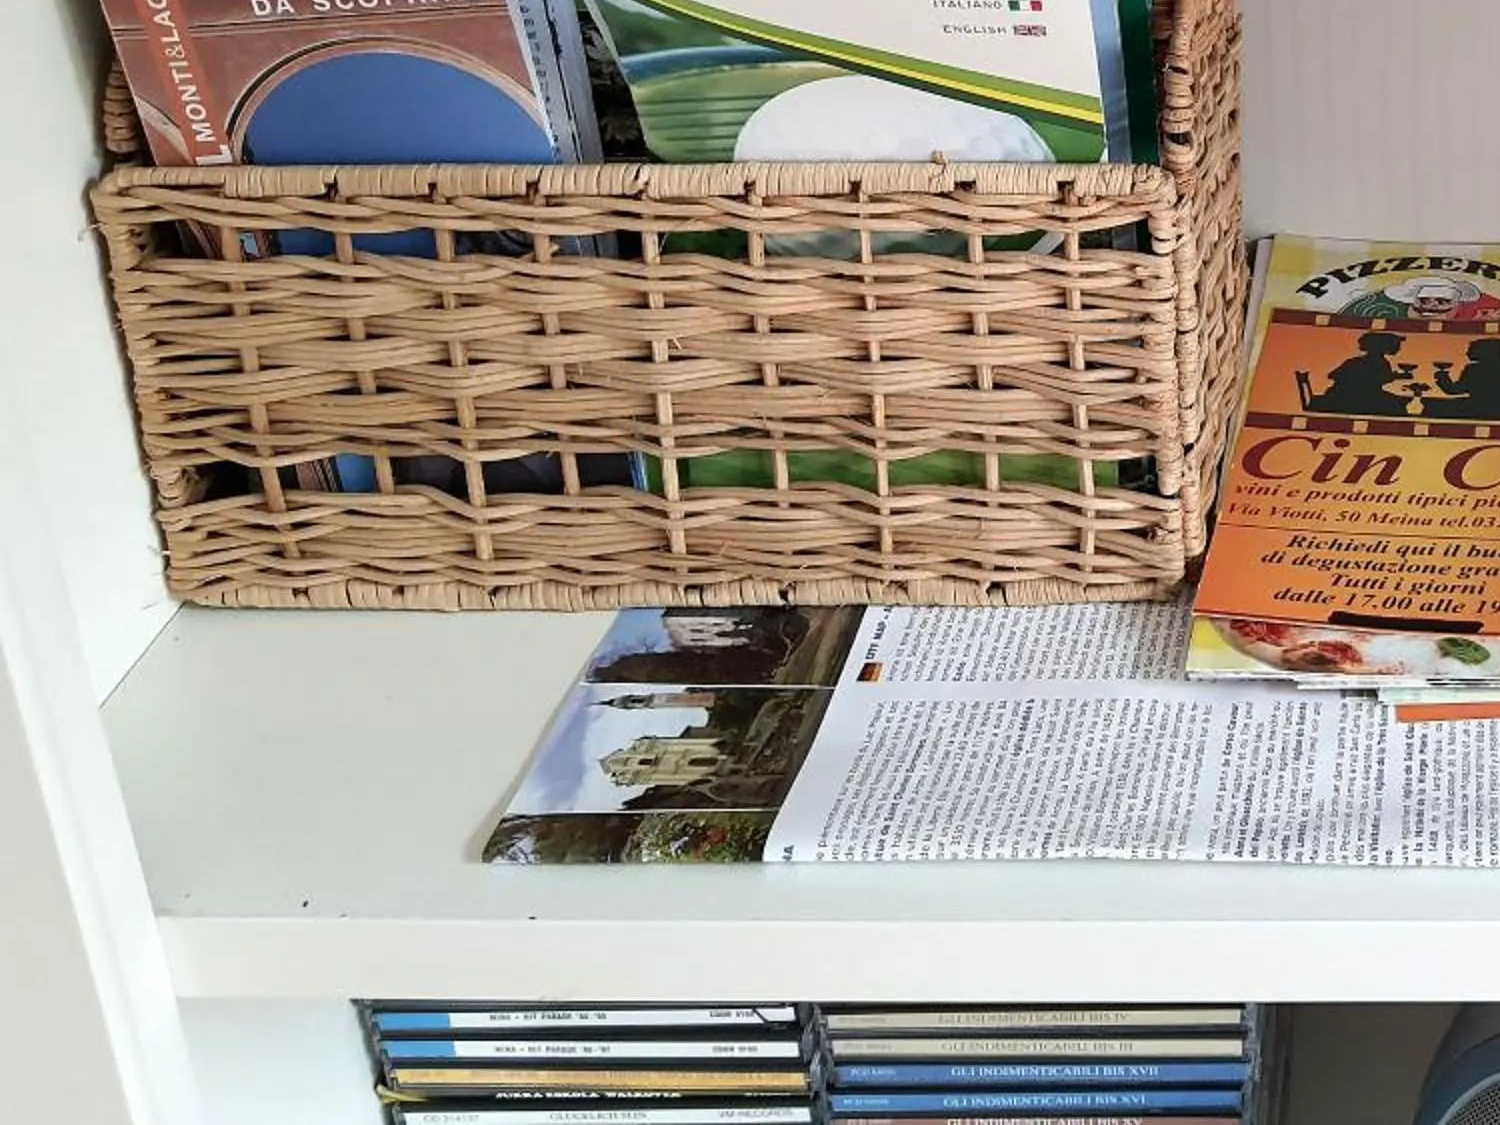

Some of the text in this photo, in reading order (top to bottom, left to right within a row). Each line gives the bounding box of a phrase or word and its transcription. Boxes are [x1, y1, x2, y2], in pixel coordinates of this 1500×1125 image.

[942, 24, 1008, 36] ENGLISH
[1241, 435, 1404, 489] Cin
[1234, 483, 1282, 498] vini
[1285, 489, 1296, 499] e
[1302, 487, 1402, 508] prodotti
[1406, 492, 1468, 510] tipici
[1228, 503, 1261, 516] Via
[1335, 510, 1362, 523] 50
[1367, 512, 1433, 528] Meina
[1286, 534, 1392, 555] Richiedi
[1396, 541, 1435, 558] qui
[1442, 542, 1461, 558] il
[1260, 550, 1285, 564] di
[1291, 551, 1453, 576] degustazione
[1330, 573, 1487, 597] Tutti i giorni
[1273, 588, 1336, 605] dalle
[1344, 593, 1413, 611] 17.00
[1416, 597, 1466, 615] alle
